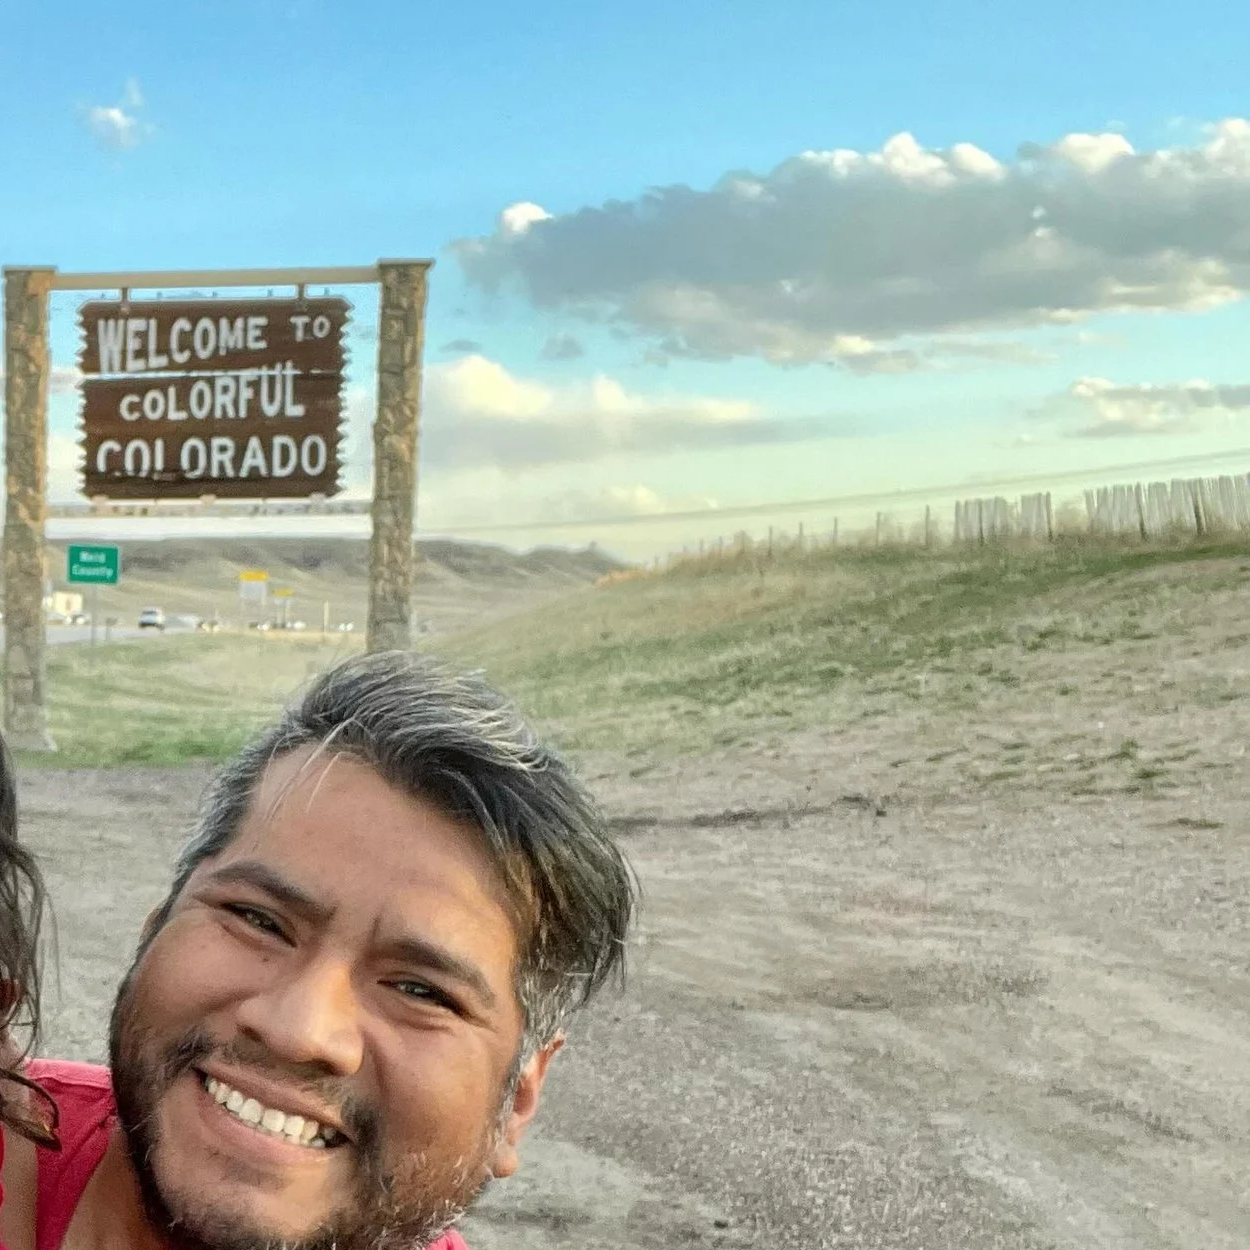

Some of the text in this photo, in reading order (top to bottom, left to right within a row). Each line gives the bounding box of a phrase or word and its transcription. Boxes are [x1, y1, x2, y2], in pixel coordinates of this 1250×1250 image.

[97, 314, 331, 374] WELCOME TO
[119, 361, 306, 422] COLORFUL
[96, 434, 328, 480] COLORADO
